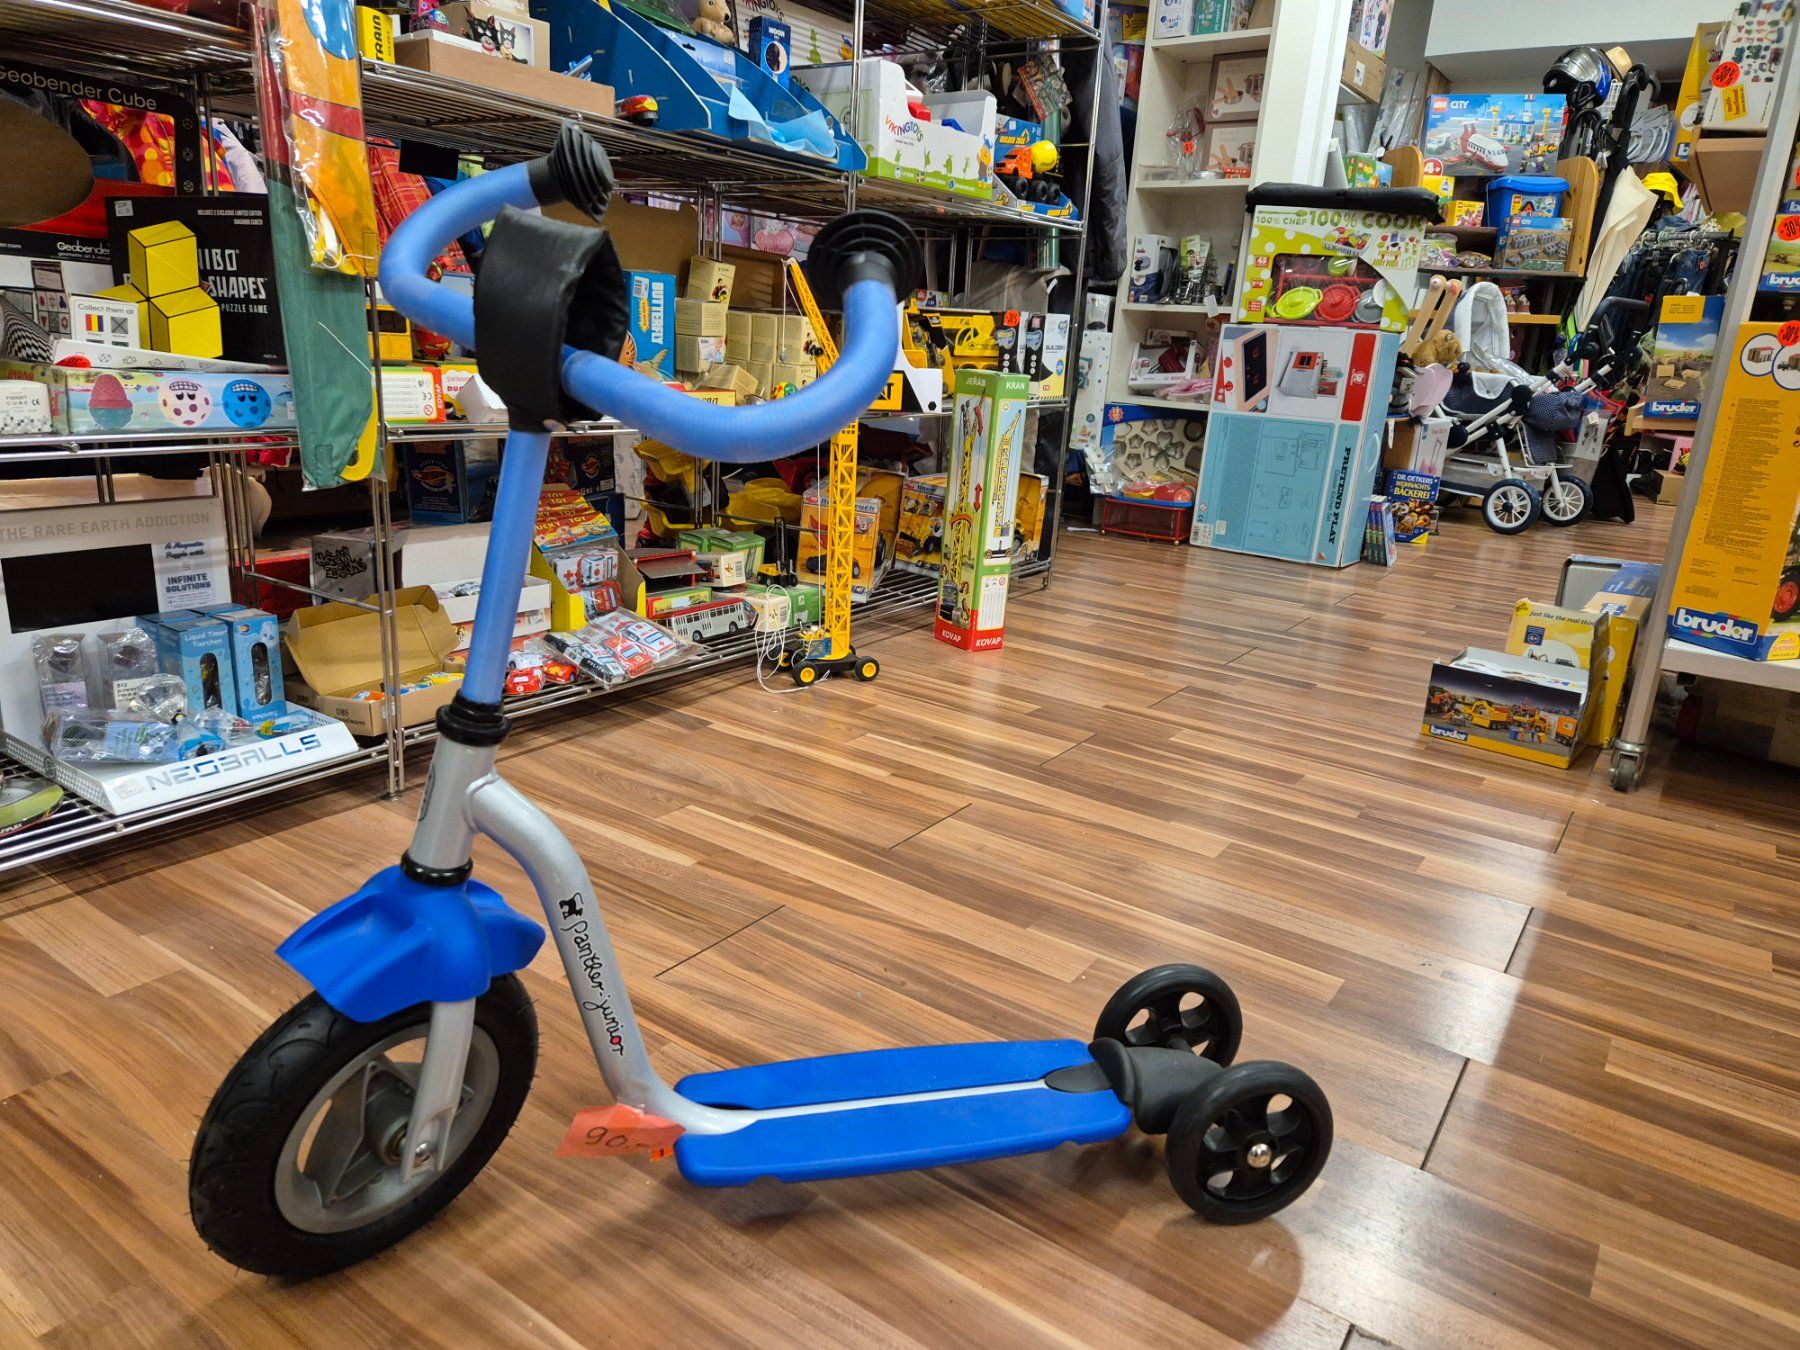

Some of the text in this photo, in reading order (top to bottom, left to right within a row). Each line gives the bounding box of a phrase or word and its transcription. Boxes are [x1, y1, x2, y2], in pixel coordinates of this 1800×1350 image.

[742, 0, 784, 21] KINGTOYS
[374, 15, 382, 61] TRAIN
[108, 87, 157, 110] Cube
[1450, 100, 1469, 109] CITY
[885, 115, 923, 142] VIKINGTOYS
[1424, 162, 1441, 173] 4+
[1283, 217, 1307, 225] CHEF
[1309, 210, 1426, 232] 100% COOK
[208, 276, 266, 299] SHAPES
[78, 303, 134, 315] Collect them all
[221, 304, 268, 314] PUZZLE GAME
[651, 281, 664, 344] BUTTERFLY
[1005, 380, 1025, 391] KRAN
[435, 383, 443, 409] KOVAP
[1652, 402, 1696, 413] bruder
[1407, 475, 1434, 485] OETKERS
[1328, 447, 1351, 545] PRETEND PLAY
[1394, 487, 1430, 499] BÄCKEREI
[0, 512, 210, 541] THE RARE EARTH ADDICTION
[536, 521, 560, 530] UCKY
[167, 573, 208, 585] INFINITE
[165, 581, 211, 593] SOLUTIONS
[1677, 608, 1754, 641] bruder
[941, 629, 961, 643] KOVAP
[975, 636, 1001, 647] KOVAP
[1430, 725, 1466, 740] bruder
[145, 734, 321, 790] NEOBALLS
